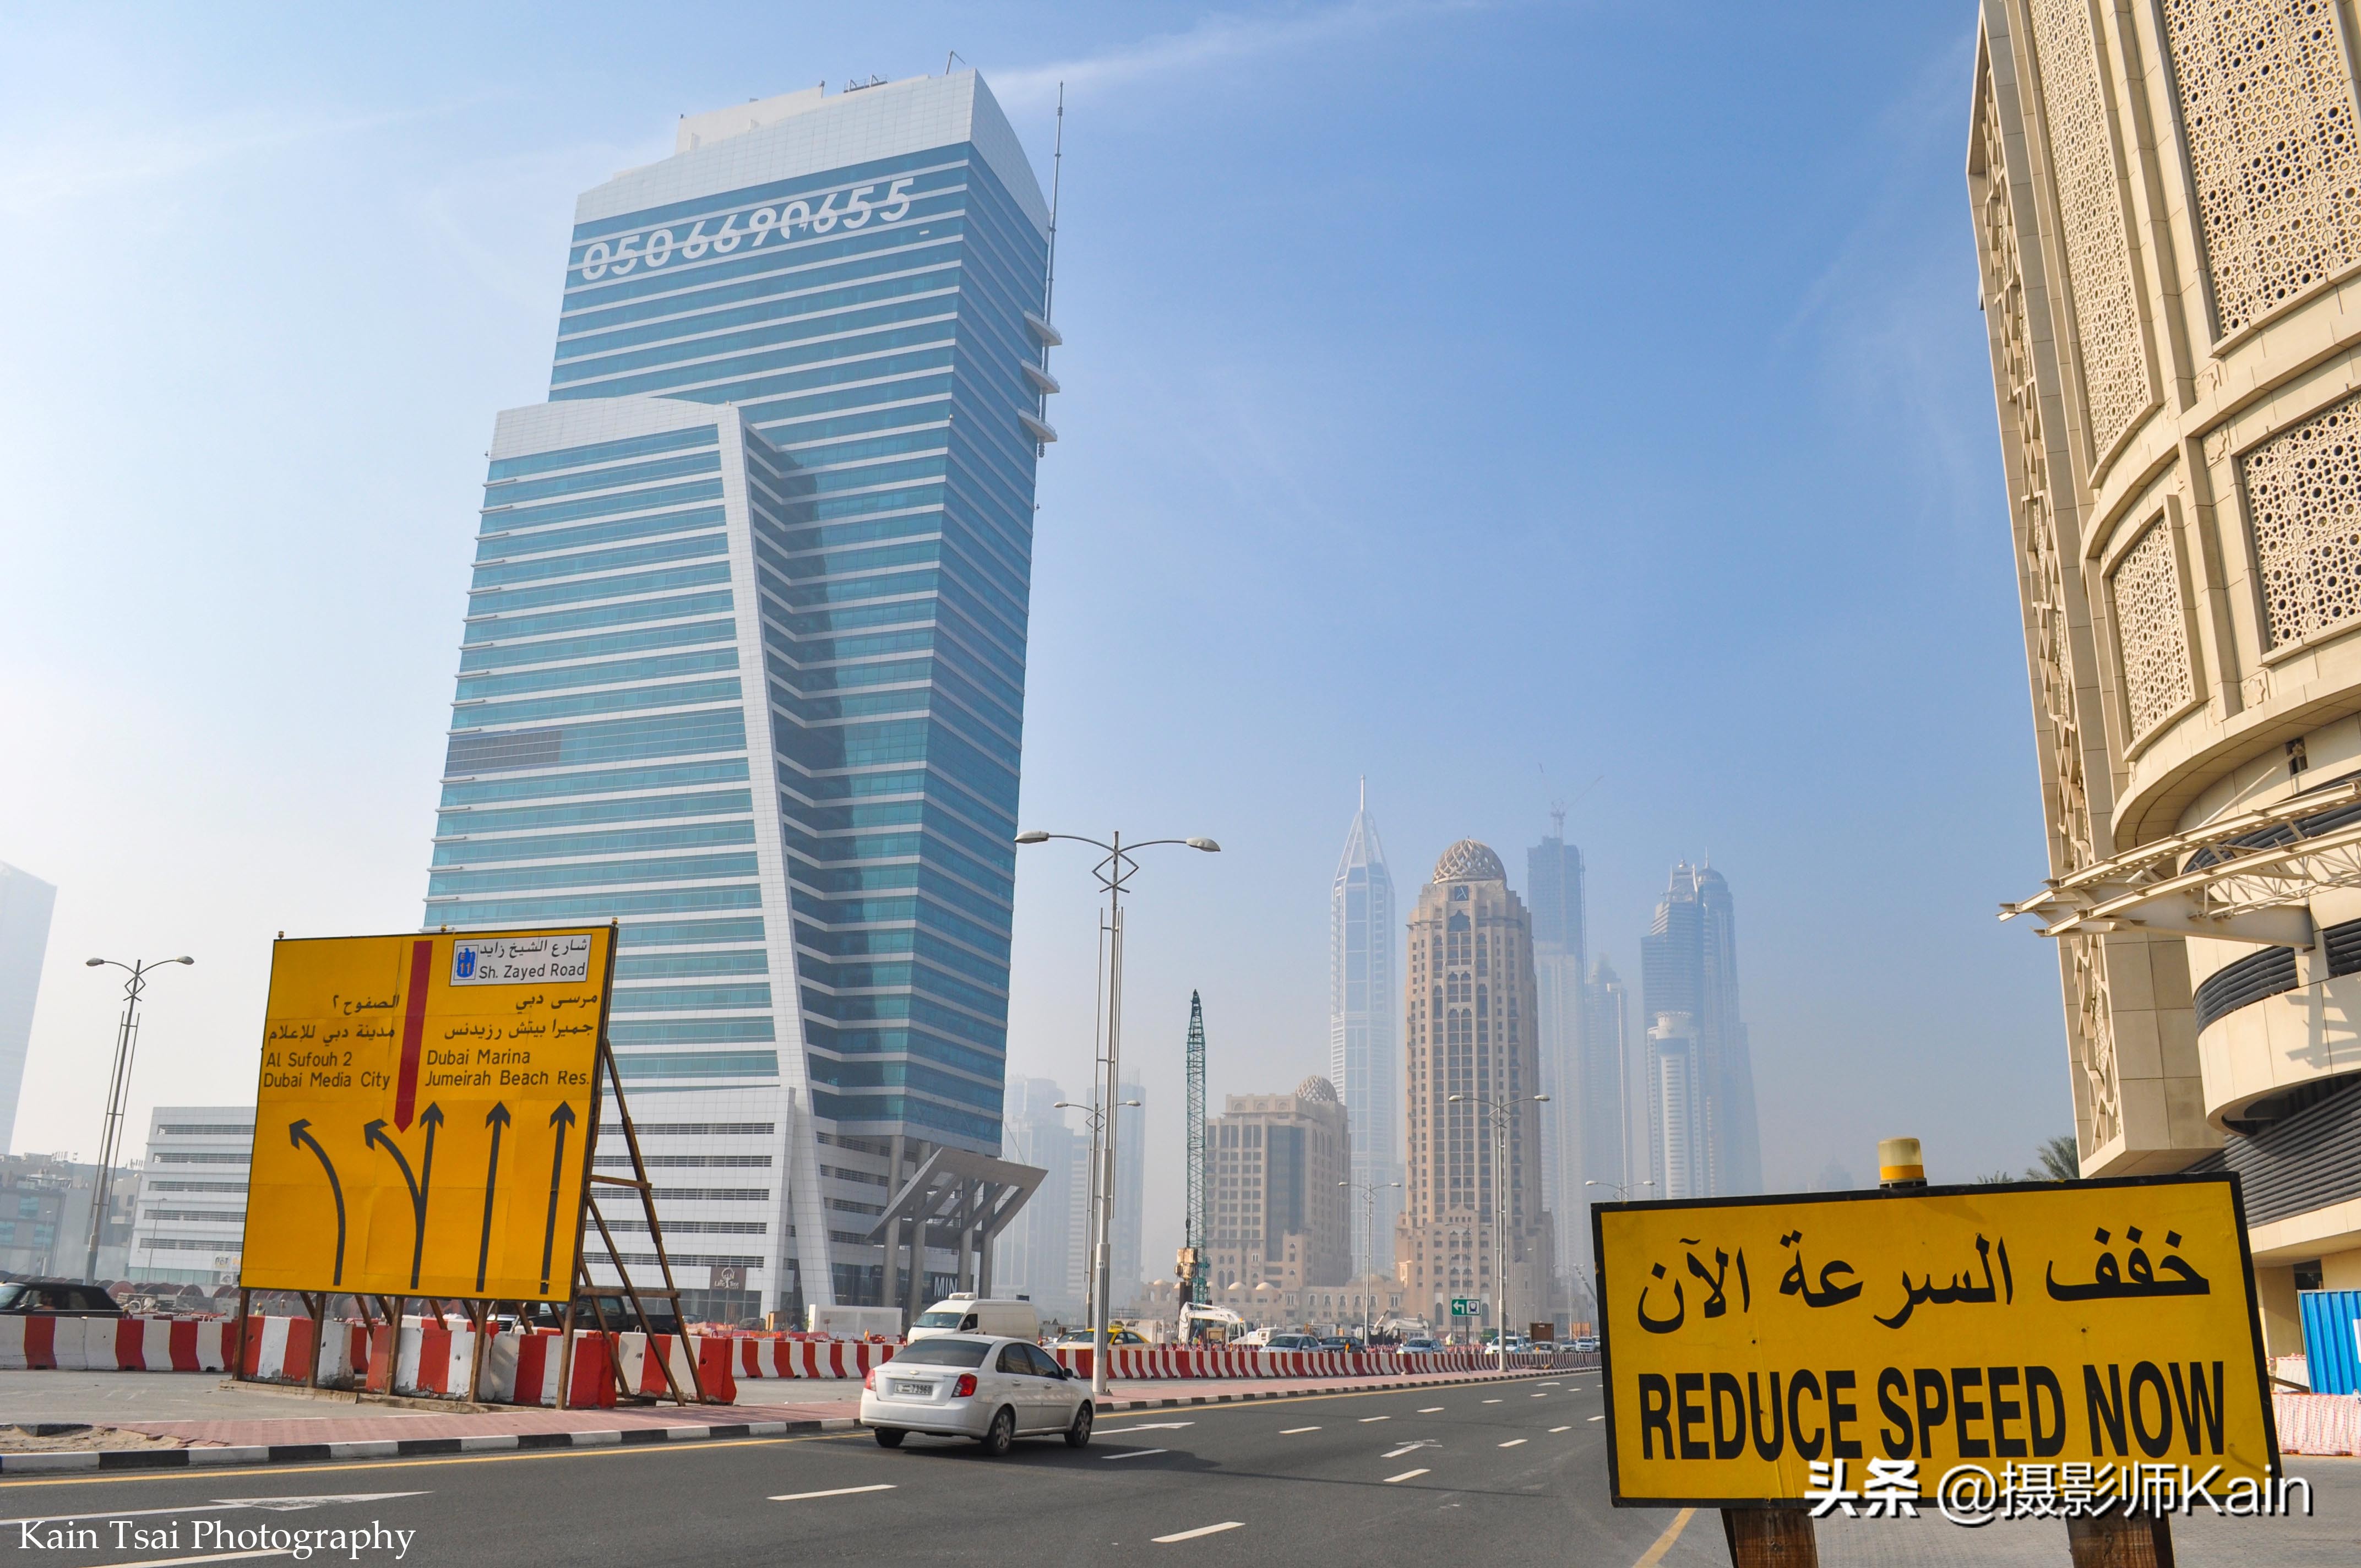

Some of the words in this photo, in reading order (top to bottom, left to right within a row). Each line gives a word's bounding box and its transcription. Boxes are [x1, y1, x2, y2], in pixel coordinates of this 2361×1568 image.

[480, 941, 505, 959] زايد
[509, 939, 548, 959] الشيخ
[551, 938, 587, 957] شارع
[461, 962, 471, 974] 11
[478, 966, 498, 979] Sh.
[503, 963, 546, 981] Zayed
[550, 962, 586, 977] Road
[343, 993, 400, 1016] الصفوح
[515, 994, 544, 1014] دبي
[551, 994, 598, 1010] مرسى
[268, 1025, 316, 1047] للإعلام
[323, 1028, 349, 1047] دبي
[355, 1024, 395, 1041] مدينة
[444, 1022, 502, 1041] رزيدنس
[508, 1020, 546, 1038] بيتش
[552, 1019, 594, 1039] جميرا
[265, 1052, 281, 1068] Al
[287, 1052, 338, 1068] Sufouh
[342, 1051, 352, 1067] 2
[426, 1048, 470, 1066] Dubai
[476, 1048, 531, 1065] Marina
[263, 1072, 303, 1088] Dubai
[309, 1071, 352, 1088] Media
[360, 1071, 391, 1091] City
[425, 1070, 491, 1087] Jumeirah
[499, 1069, 549, 1086] Beach
[557, 1070, 590, 1085] Res.
[2045, 1225, 2211, 1302] خفف
[1636, 1237, 1751, 1335] الآن
[1778, 1229, 2014, 1330] السرعة
[1638, 1368, 1864, 1461] REDUCE
[1876, 1365, 2066, 1460] SPEED
[2082, 1360, 2225, 1459] NOW
